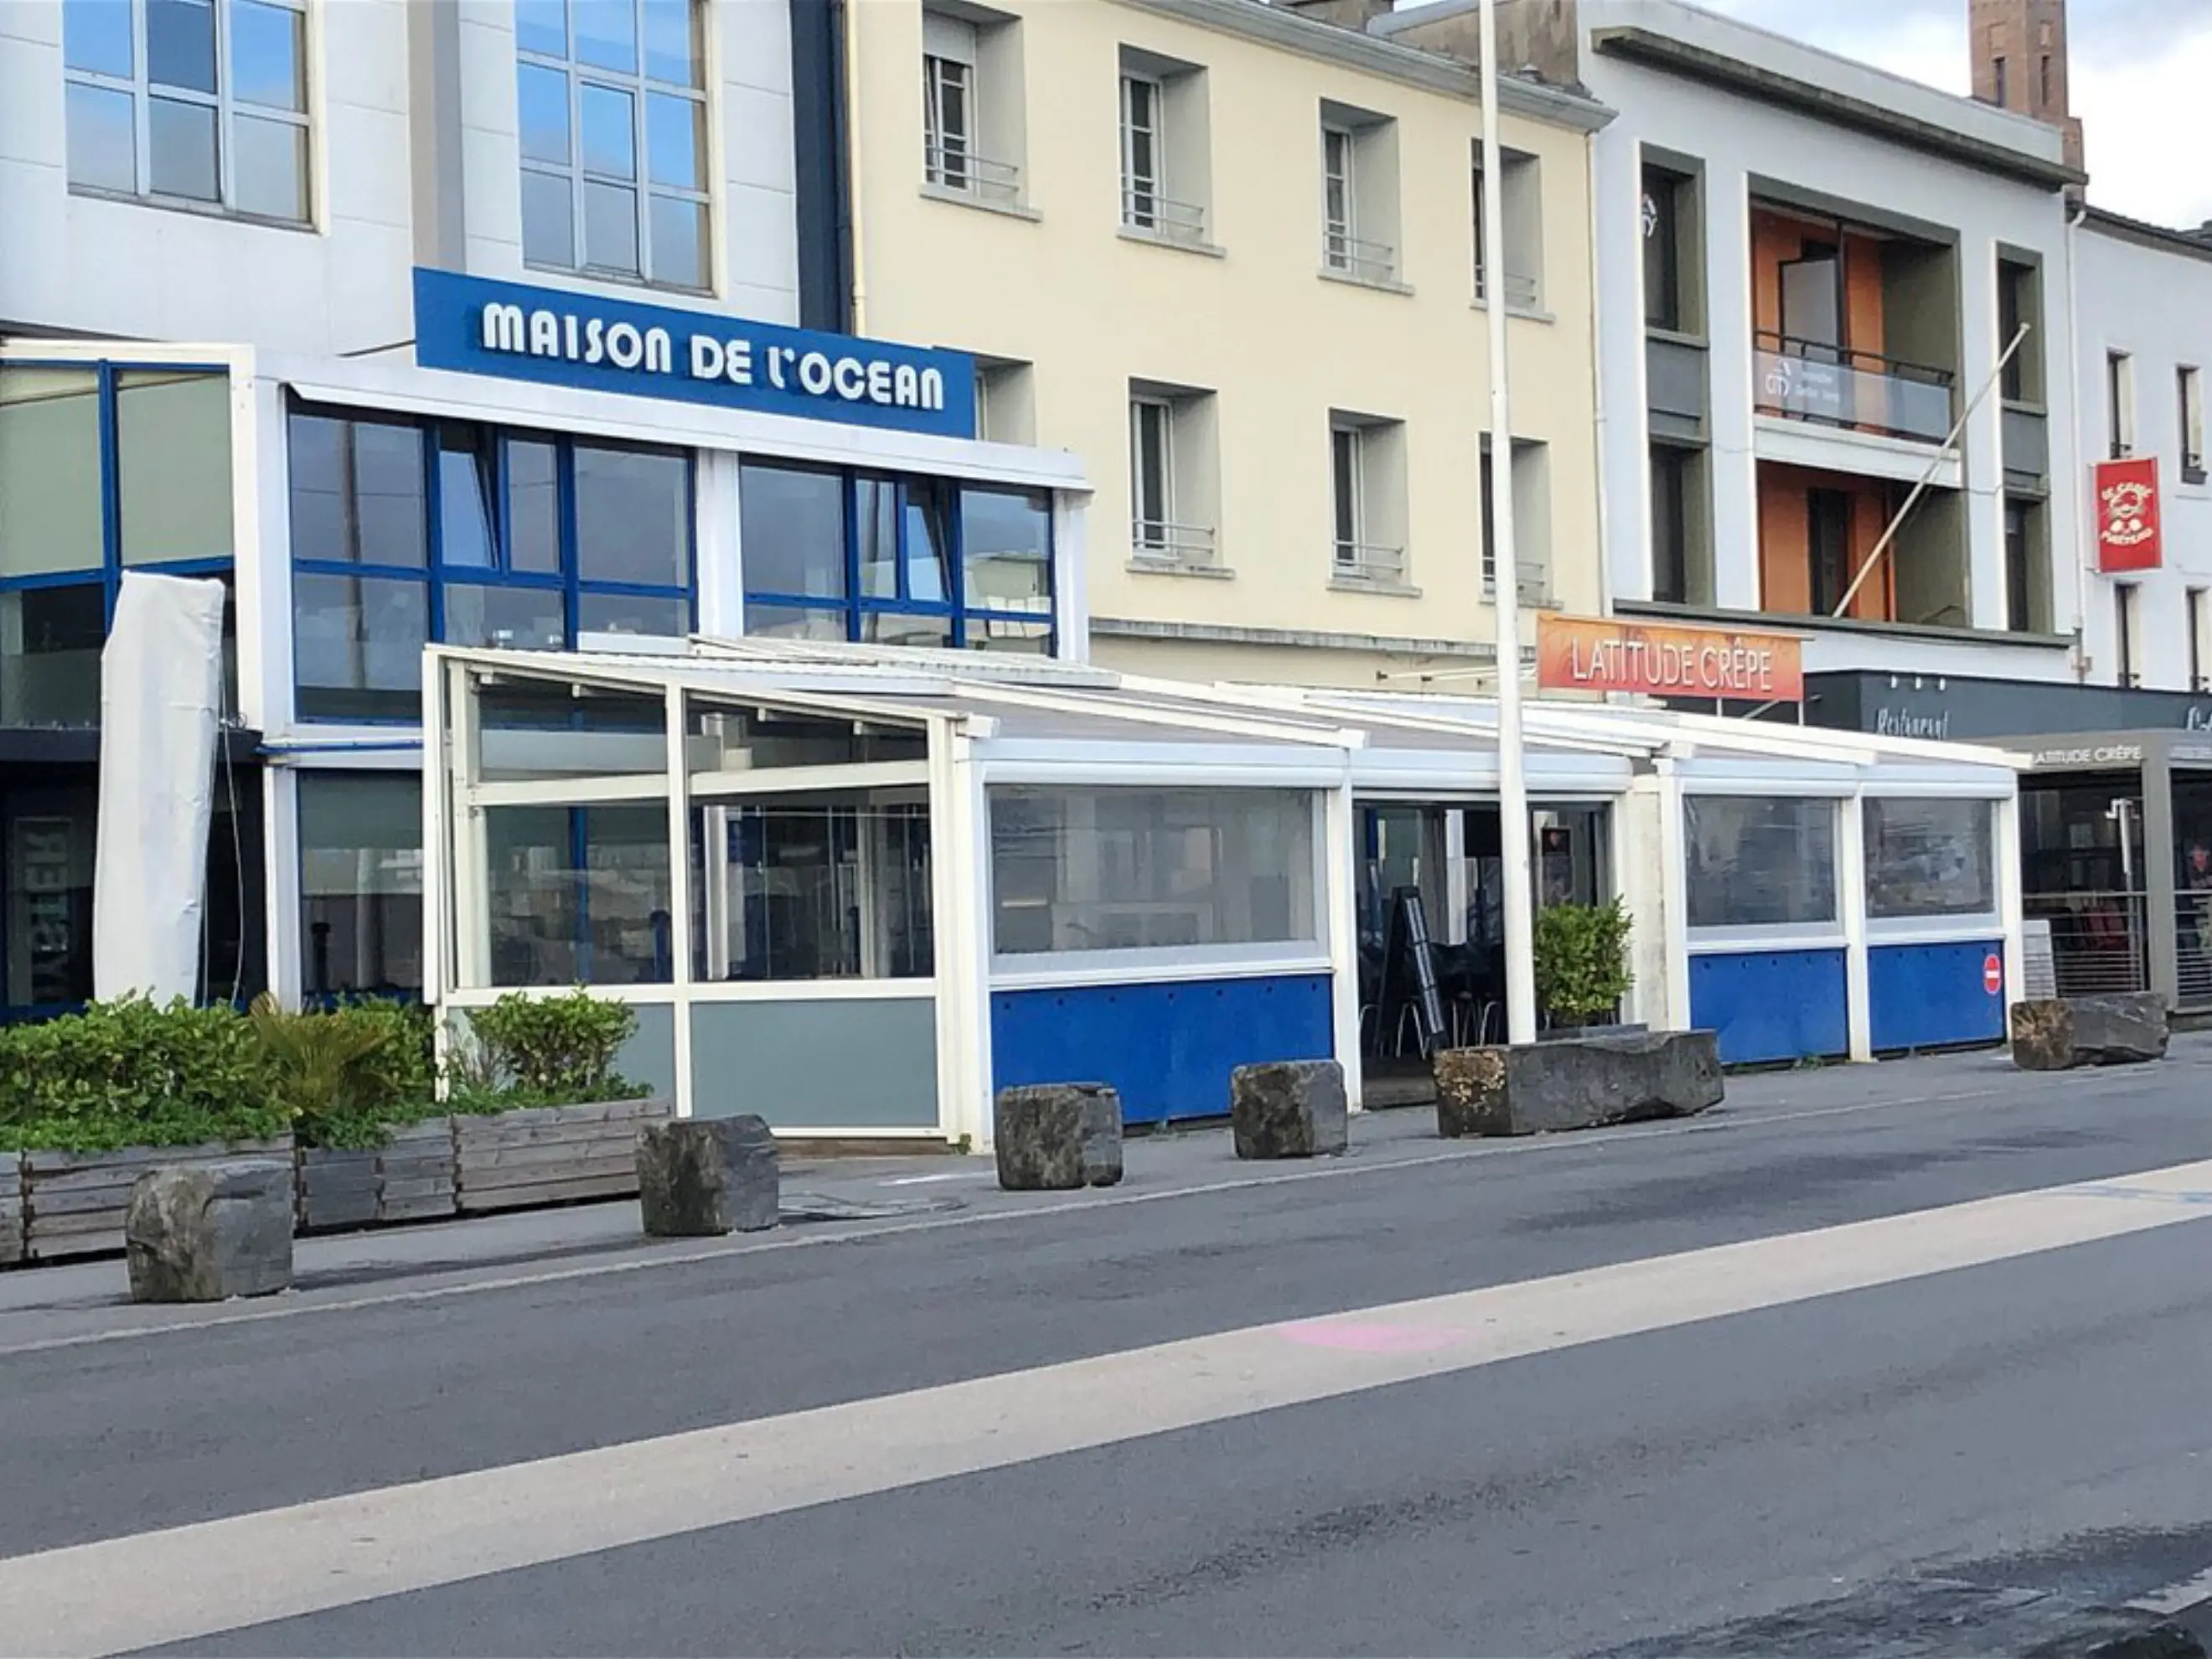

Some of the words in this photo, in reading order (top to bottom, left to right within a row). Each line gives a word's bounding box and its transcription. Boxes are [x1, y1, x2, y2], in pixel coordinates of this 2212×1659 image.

[483, 302, 672, 374] MAISON
[691, 335, 752, 385] DE
[767, 346, 943, 410] L'OCEAN
[1571, 637, 1694, 687] LATITUDE
[1700, 636, 1773, 690] CRÊPE
[2034, 748, 2091, 764] ATITUDE
